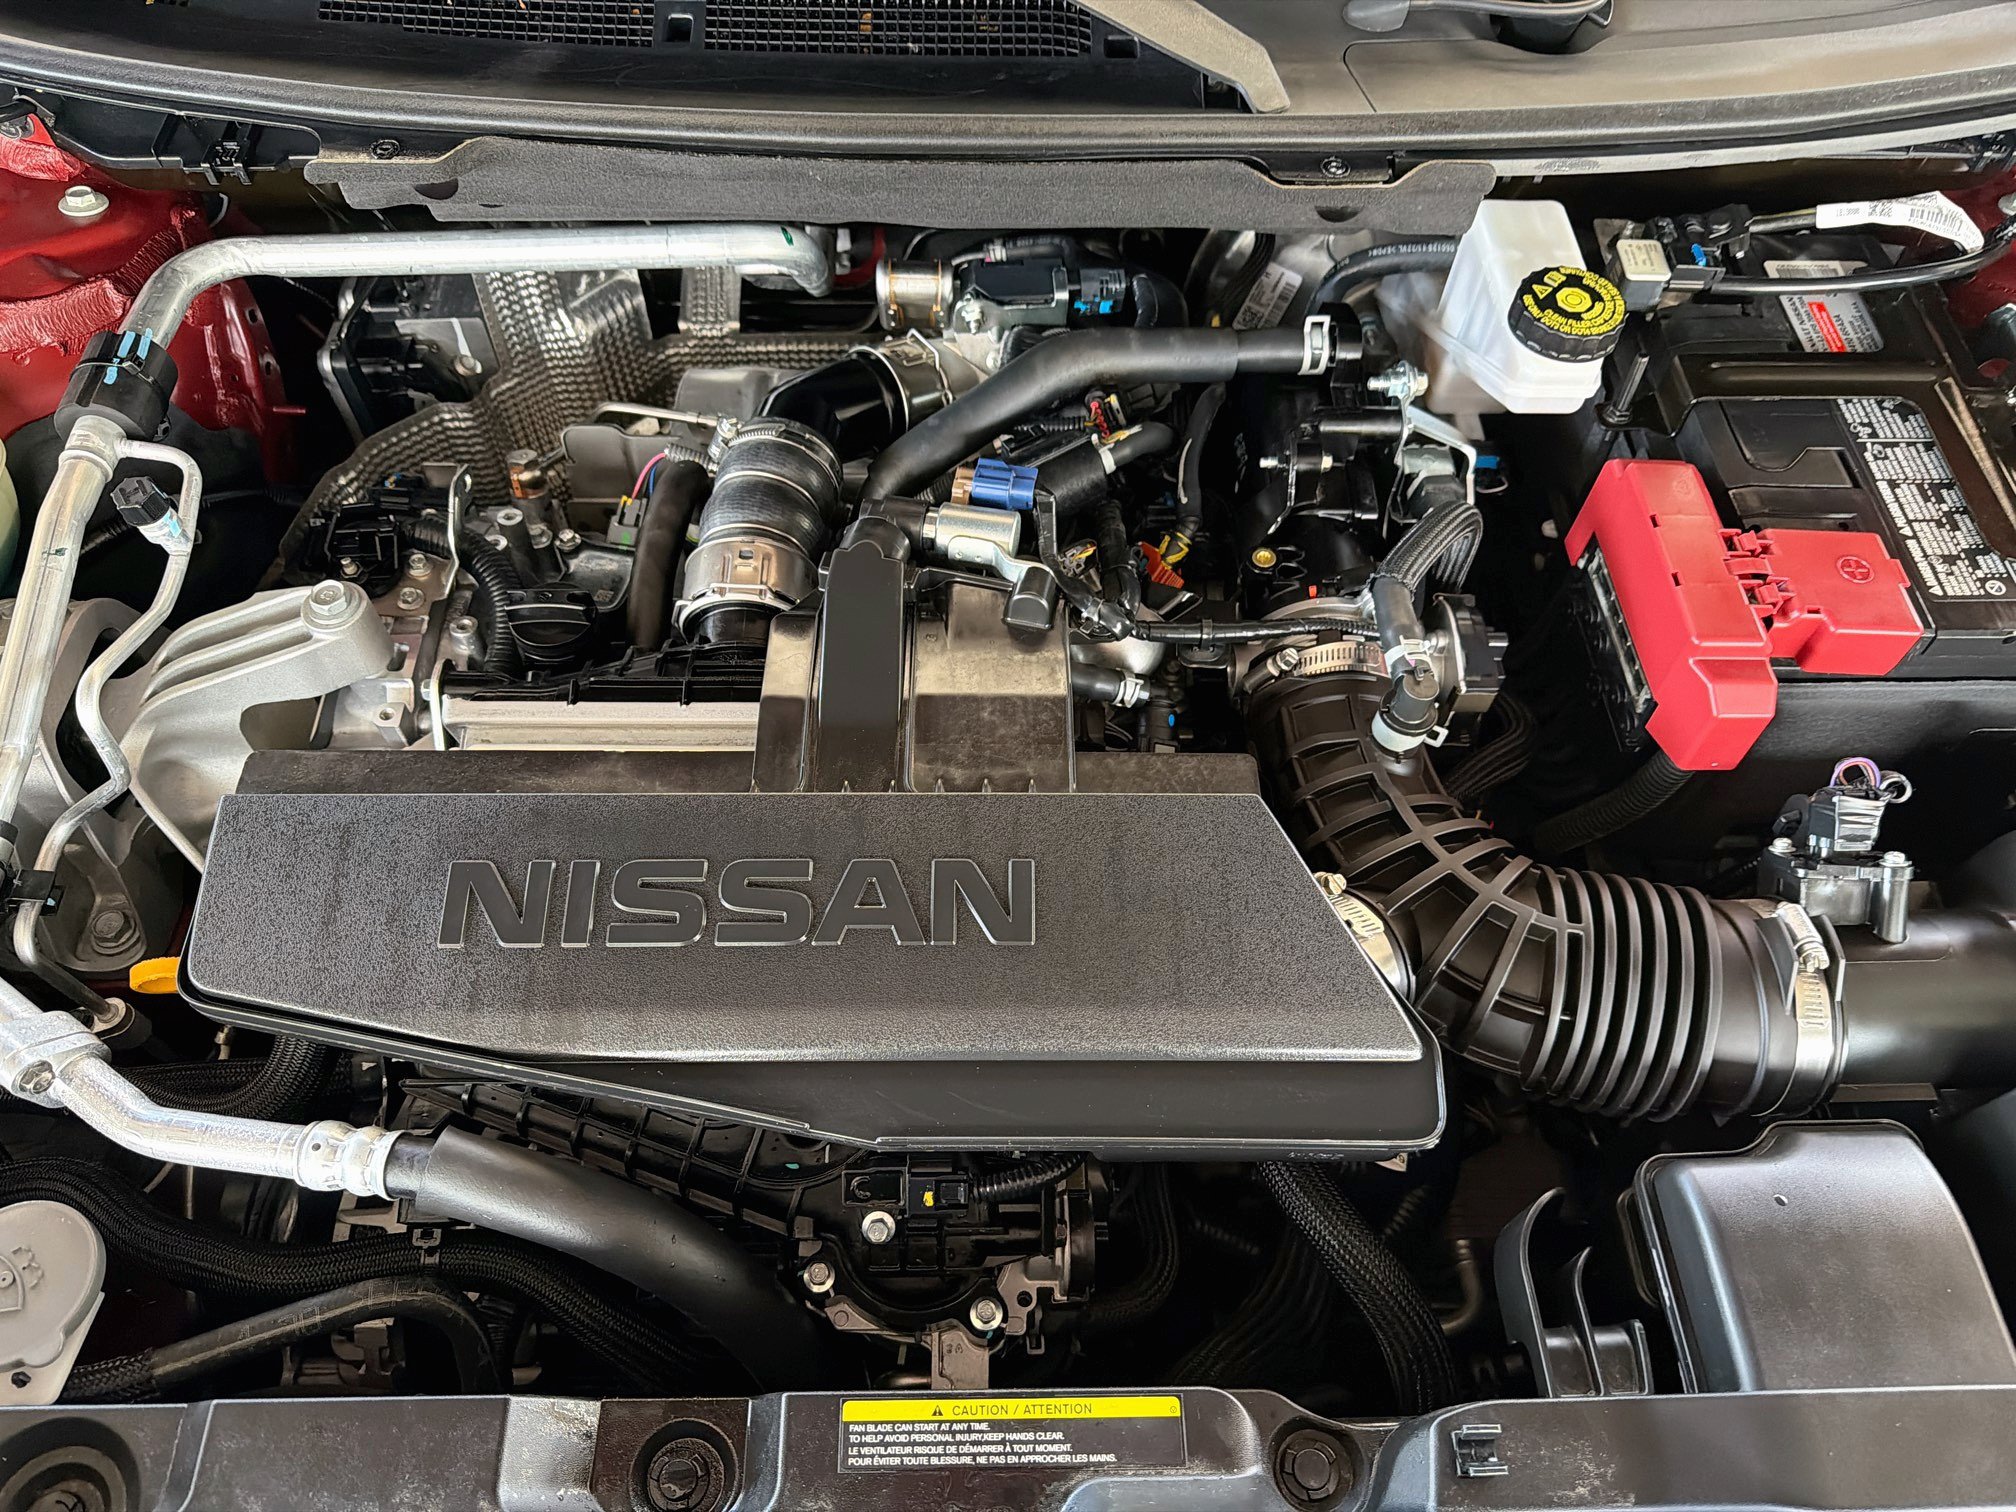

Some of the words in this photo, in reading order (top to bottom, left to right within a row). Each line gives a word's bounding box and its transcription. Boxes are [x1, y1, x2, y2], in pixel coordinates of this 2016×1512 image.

[437, 858, 1035, 949] NISSAN
[952, 1404, 1008, 1416] CAUTION
[1013, 1404, 1019, 1415] /
[1023, 1403, 1092, 1414] ATTENTION
[849, 1424, 865, 1432] FAN
[867, 1424, 893, 1432] BLADE
[894, 1424, 912, 1432] CAN
[914, 1423, 939, 1432] START
[940, 1423, 950, 1431] AT
[951, 1423, 969, 1431] ANY
[970, 1422, 991, 1431] TIME.
[849, 1434, 860, 1443] TO
[862, 1434, 883, 1443] HELP
[884, 1434, 909, 1443] AVOID
[911, 1433, 954, 1442] PERSONAL
[1005, 1432, 1035, 1440] HANDS
[1036, 1432, 1065, 1440] CLEAR.
[849, 1447, 859, 1455] LE
[860, 1446, 912, 1455] VENTILATEUR
[914, 1445, 943, 1454] RISQUE
[946, 1445, 957, 1453] DE
[959, 1442, 1004, 1453] DÉMARRER
[1005, 1443, 1012, 1452] À
[1035, 1444, 1073, 1452] MOMENT.
[848, 1457, 872, 1466] POUR
[873, 1455, 901, 1465] ÉVITER
[902, 1456, 929, 1465] TOUTE
[930, 1456, 975, 1465] BLESSURE,
[976, 1456, 988, 1464] NE
[989, 1455, 1006, 1464] PAS
[1020, 1455, 1071, 1463] APPROCHER
[1090, 1454, 1118, 1462] MAINS.
